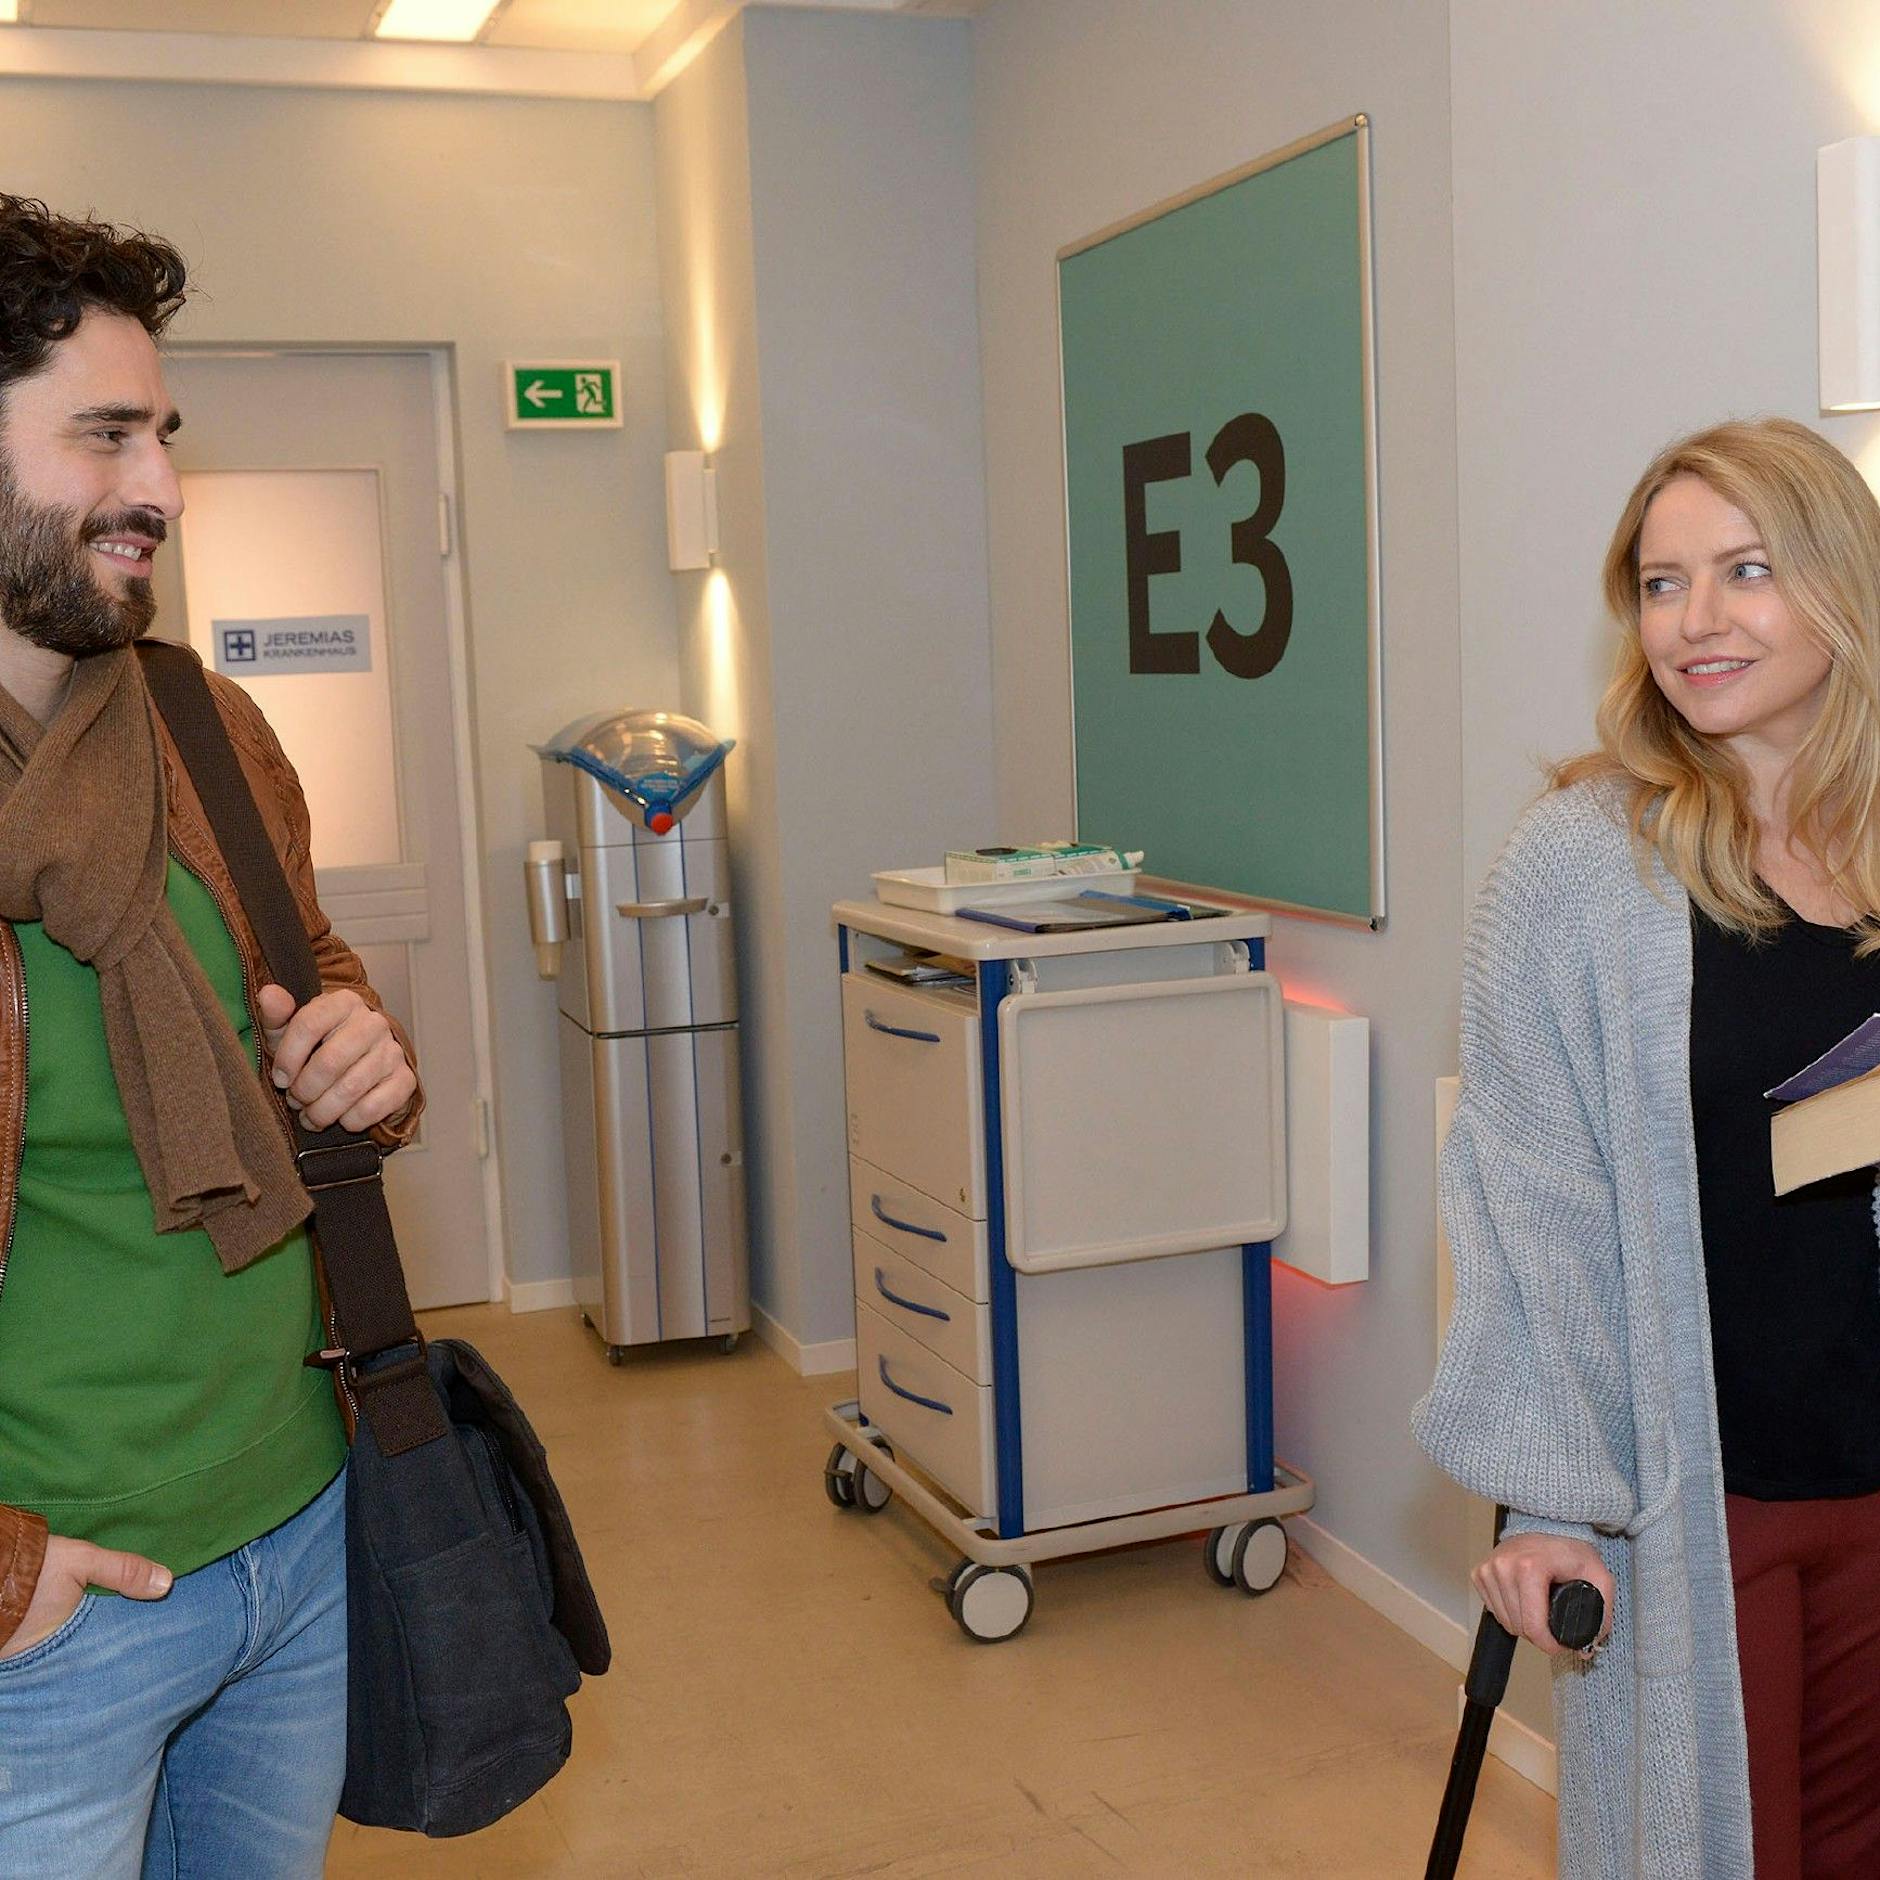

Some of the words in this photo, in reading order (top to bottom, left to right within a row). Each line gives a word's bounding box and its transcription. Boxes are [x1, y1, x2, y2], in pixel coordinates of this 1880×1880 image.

[1123, 412, 1293, 679] E3
[263, 630, 355, 647] JEREMIAS
[263, 646, 357, 658] KRANKENHAUS
